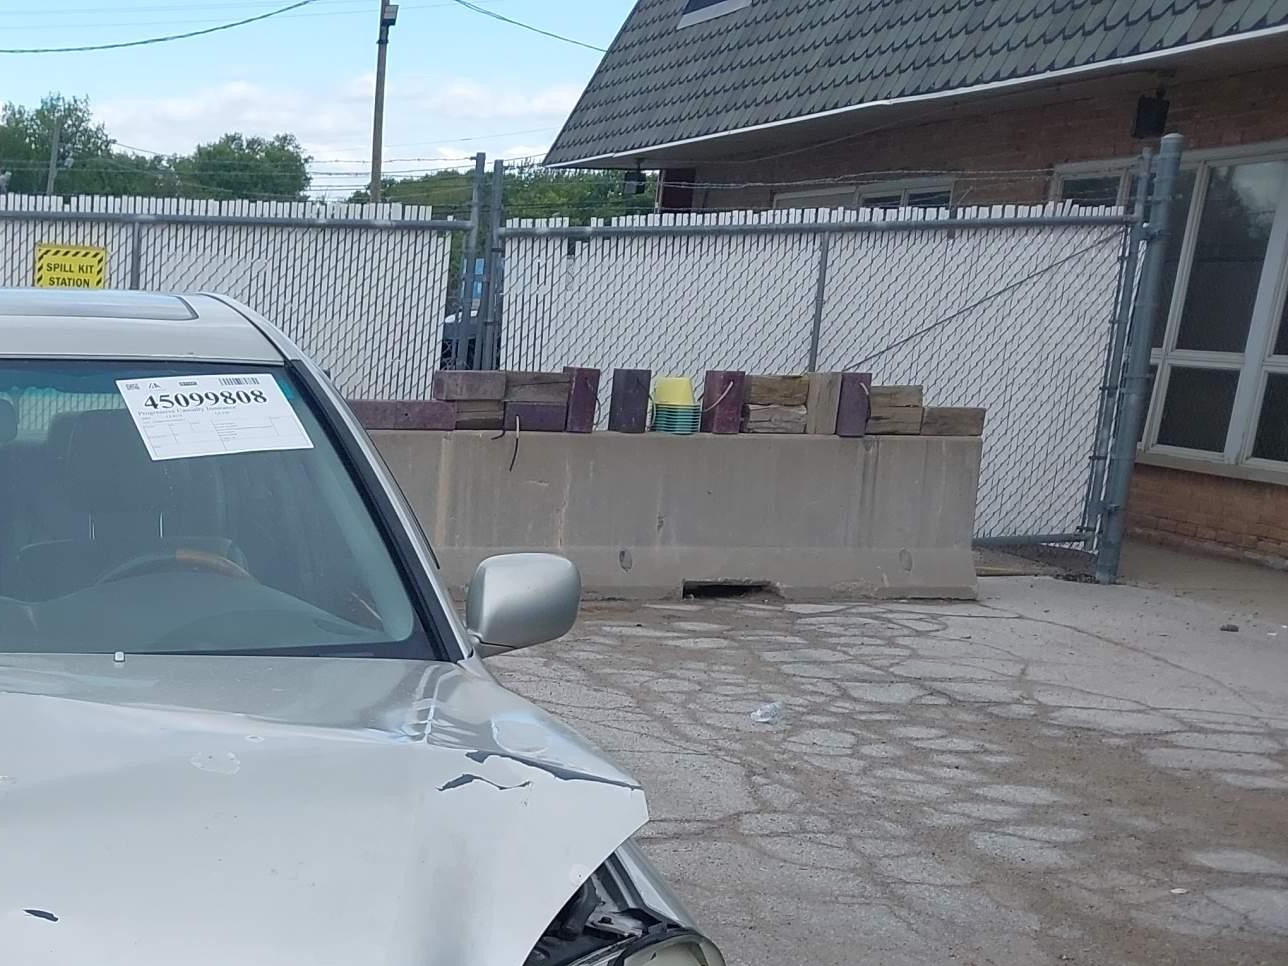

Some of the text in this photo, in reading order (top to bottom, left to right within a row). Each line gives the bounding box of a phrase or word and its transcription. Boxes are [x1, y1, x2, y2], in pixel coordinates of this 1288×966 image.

[46, 262, 95, 274] SPILL KIT
[48, 276, 90, 288] STATION
[144, 389, 267, 409] 45099808
